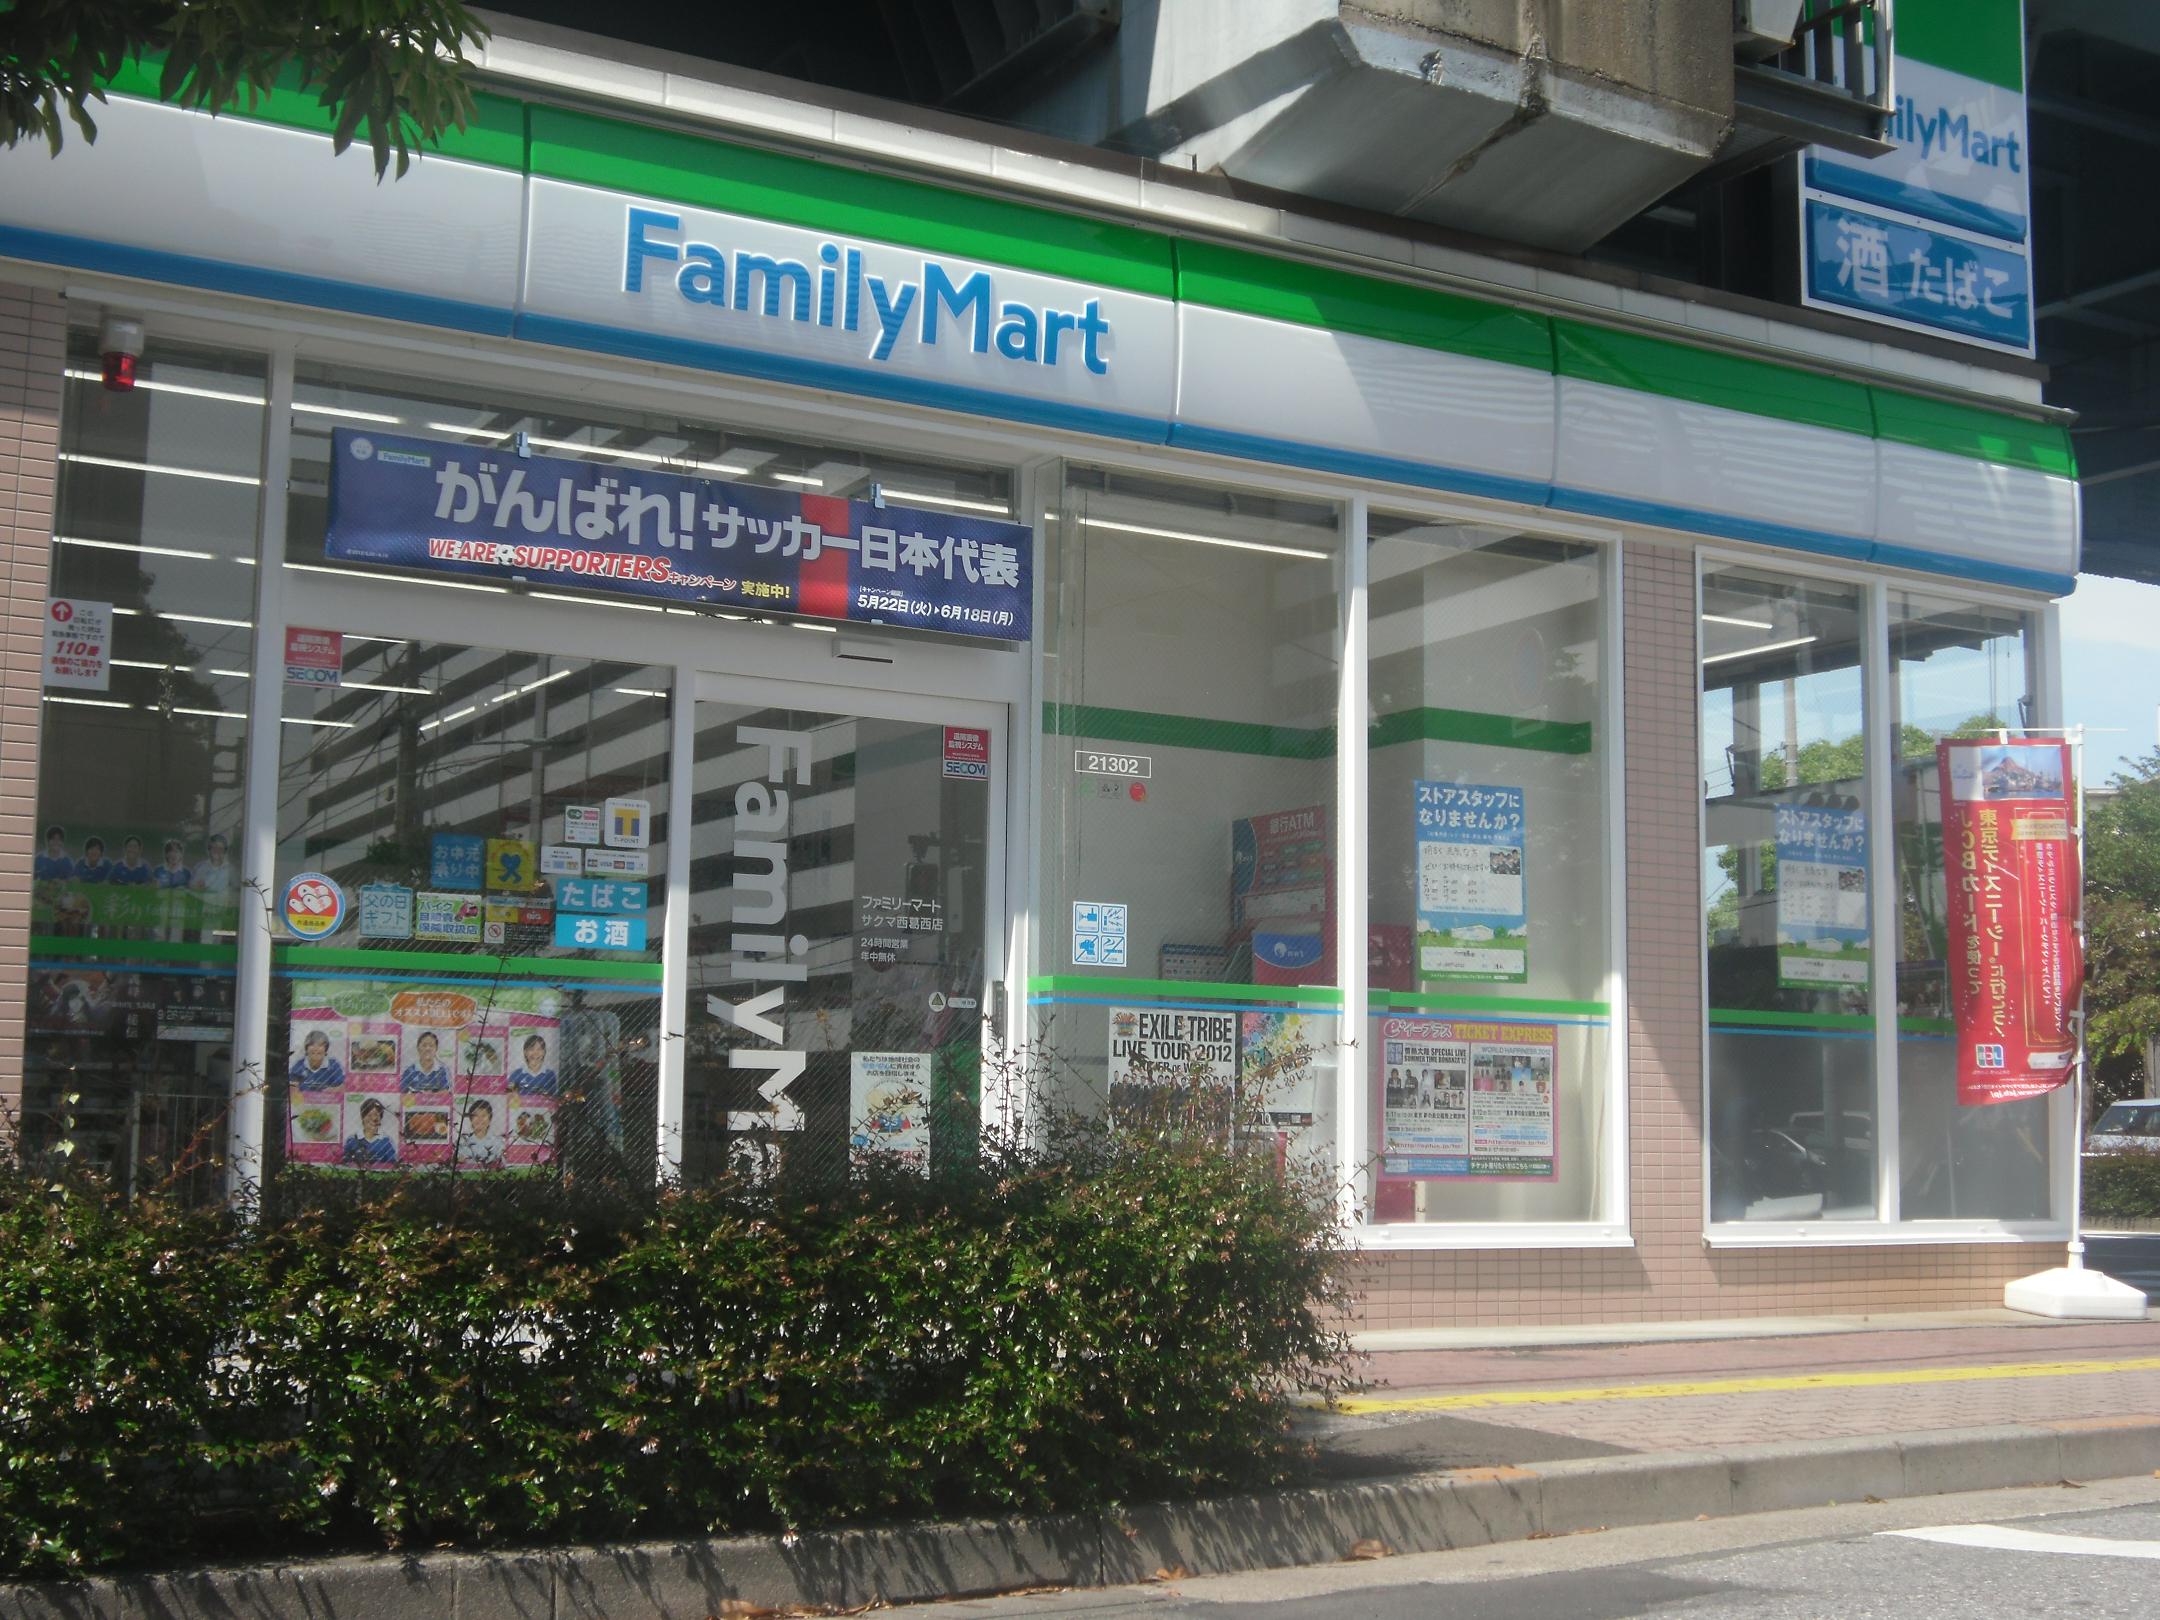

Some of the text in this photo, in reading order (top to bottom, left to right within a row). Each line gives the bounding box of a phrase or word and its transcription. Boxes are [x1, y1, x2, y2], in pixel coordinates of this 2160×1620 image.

[1888, 95, 2021, 174] ilyMart
[1836, 217, 2013, 320] 酒 たばこ
[622, 204, 1110, 375] FamilyMart
[434, 461, 1021, 588] がんばれ! サッカー日本代表
[428, 537, 791, 600] WE ARE SUPPORTERS キャンペーン 実施中!
[286, 666, 338, 684] SECOM
[945, 761, 986, 776] SECOM
[1088, 755, 1139, 774] 21302
[1419, 786, 1520, 809] ストアスタッフに
[1419, 807, 1521, 832] なりませんか?
[1778, 808, 1865, 831] ストアスタッフに
[1778, 829, 1865, 853] なりませんか?
[434, 845, 481, 861] お中元
[434, 863, 480, 878] 承り中
[364, 894, 408, 908] 父の日
[562, 881, 641, 910] たばこ
[861, 895, 942, 913] ファミリーマート
[419, 901, 454, 912] バイク
[364, 911, 407, 926] ギフト
[861, 914, 944, 931] サクマ西葛西店
[574, 919, 630, 947] お酒
[861, 937, 909, 949] 24時間営業
[706, 725, 813, 1188] FamilyMa
[861, 951, 896, 963] 年中無休
[1139, 1013, 1233, 1043] EXILE TRIBE
[1454, 1023, 1498, 1041] TICKET
[1501, 1025, 1554, 1042] EXPRESS
[1113, 1040, 1232, 1063] LIVE TOUR 2012
[1404, 1055, 1425, 1063] SUMMER
[1431, 1048, 1454, 1057] SPECIAL
[1455, 1049, 1466, 1057] LIVE
